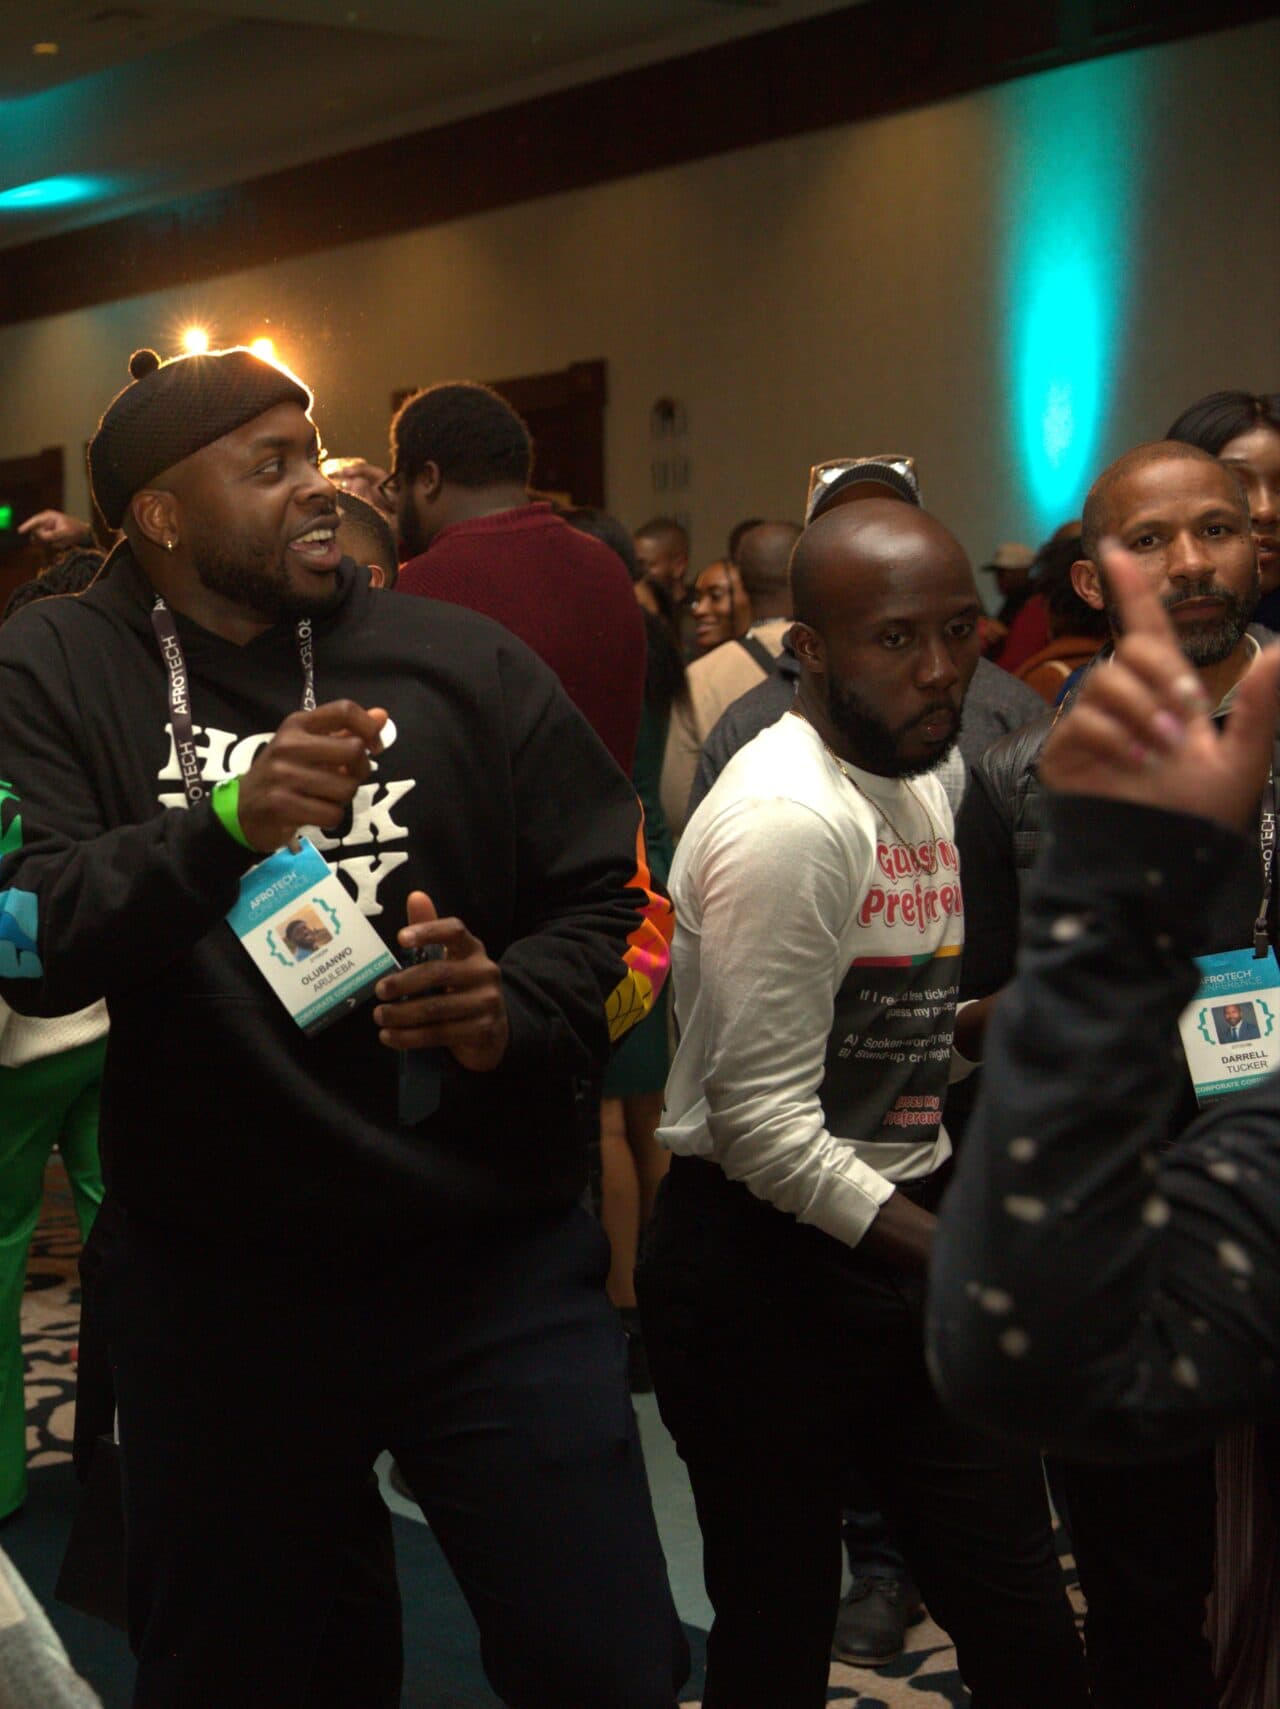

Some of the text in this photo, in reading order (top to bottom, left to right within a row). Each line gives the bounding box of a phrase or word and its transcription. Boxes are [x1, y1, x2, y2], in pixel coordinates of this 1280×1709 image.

[162, 634, 189, 716] AFROTECH
[179, 741, 204, 804] OTECH
[249, 870, 298, 910] AFROTECH
[300, 945, 354, 987] OLUBANWO
[913, 1006, 931, 1018] my
[843, 1033, 860, 1047] A)
[1220, 1050, 1269, 1065] DARRELL
[1226, 1060, 1269, 1075] TUCKER
